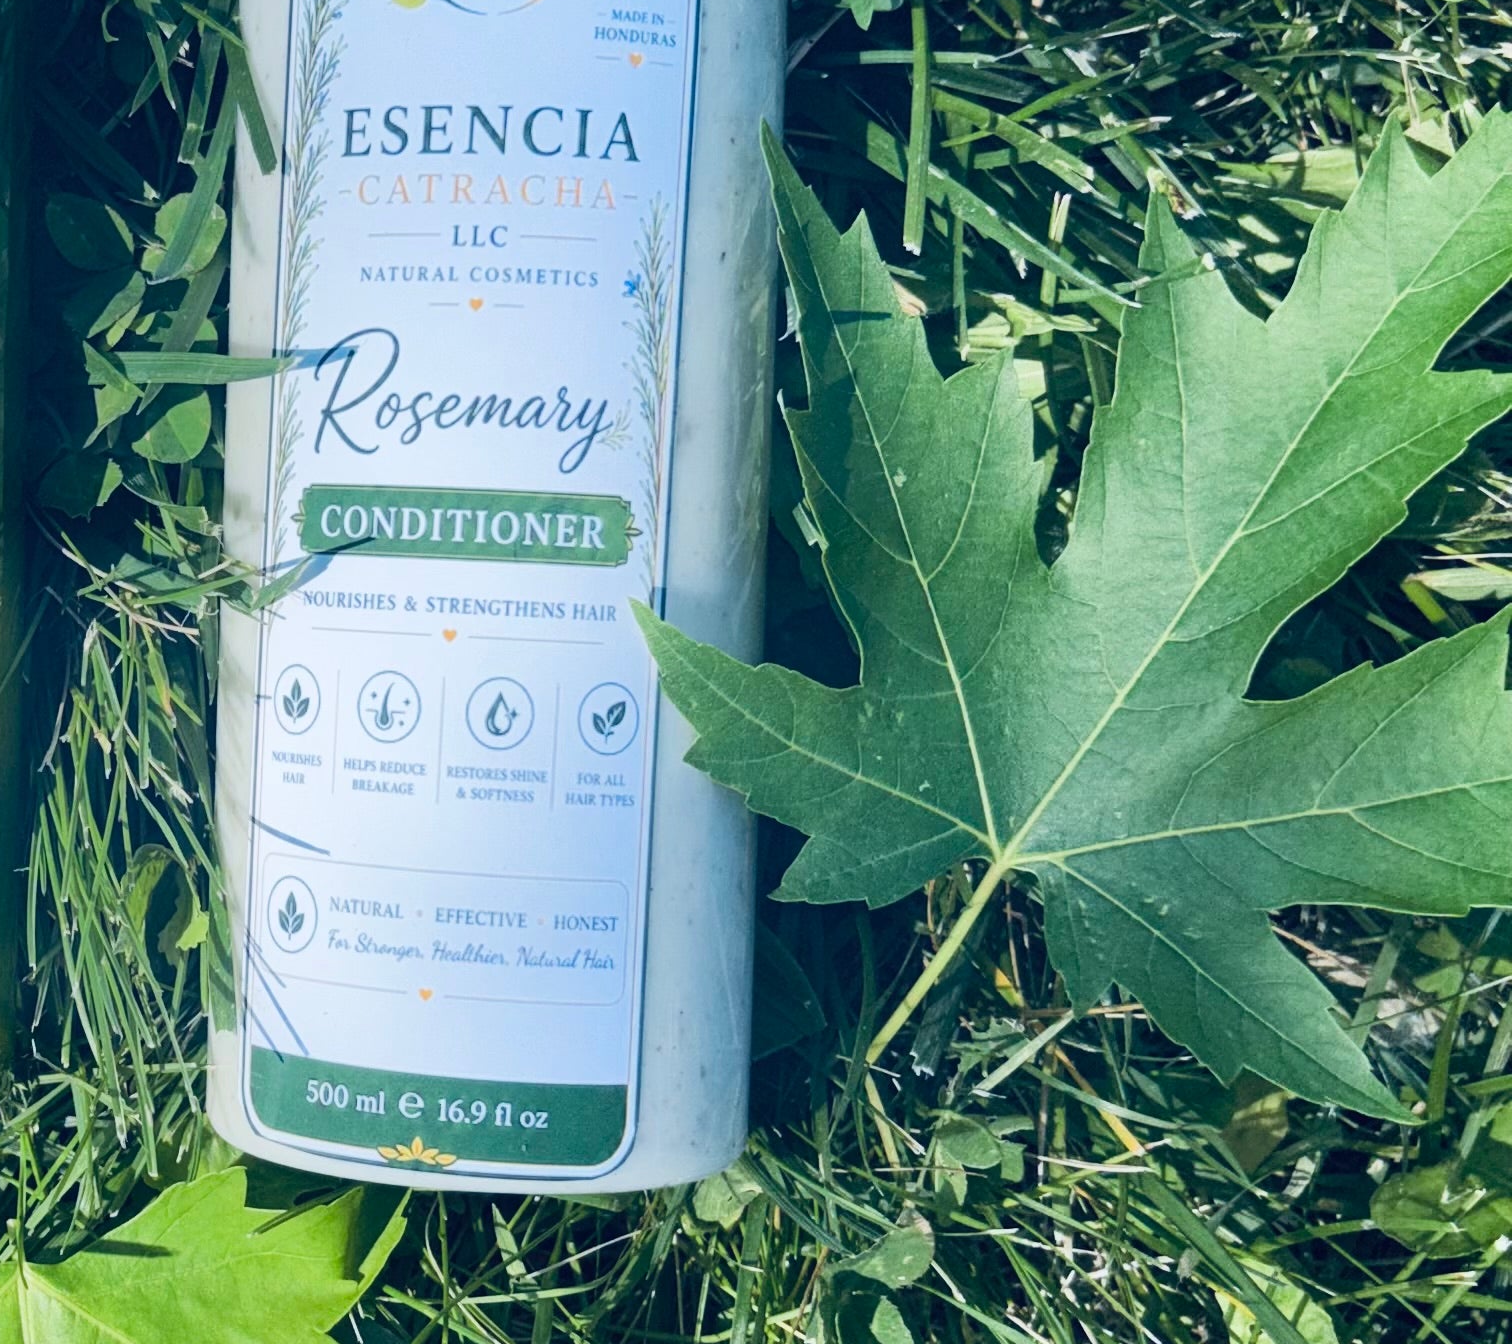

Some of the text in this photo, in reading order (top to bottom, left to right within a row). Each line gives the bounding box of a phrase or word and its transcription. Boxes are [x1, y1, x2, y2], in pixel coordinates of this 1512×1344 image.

[612, 9, 665, 25] MADE IN
[594, 26, 677, 48] HONDURAS
[341, 105, 640, 162] ESENCIA
[451, 225, 508, 248] LLC
[360, 266, 599, 287] NATURAL COSMETICS
[314, 328, 613, 474] Rosemary
[320, 504, 606, 550] CONDITIONER
[303, 590, 617, 622] NOURISHES & STRENGTHENS HAIR
[272, 751, 322, 767] NOURISHES
[344, 758, 427, 776] HELPS REDUCE
[282, 772, 305, 785] HAIR
[447, 766, 548, 783] RESTORES SHINE
[576, 772, 626, 787] FOR ALL
[352, 779, 414, 795] BREAKAGE
[456, 787, 535, 802] & SOFTNESS
[565, 792, 635, 808] HAIR TYPES
[329, 896, 619, 932] NATURAL EFFECTIVE HONEST
[328, 929, 351, 951] For
[517, 946, 578, 969] Natural
[583, 949, 616, 970] Hair
[306, 1079, 349, 1109] 500
[356, 1088, 386, 1115] ml
[438, 1097, 487, 1125] 16.9
[494, 1102, 513, 1127] fl
[520, 1108, 548, 1129] oz
